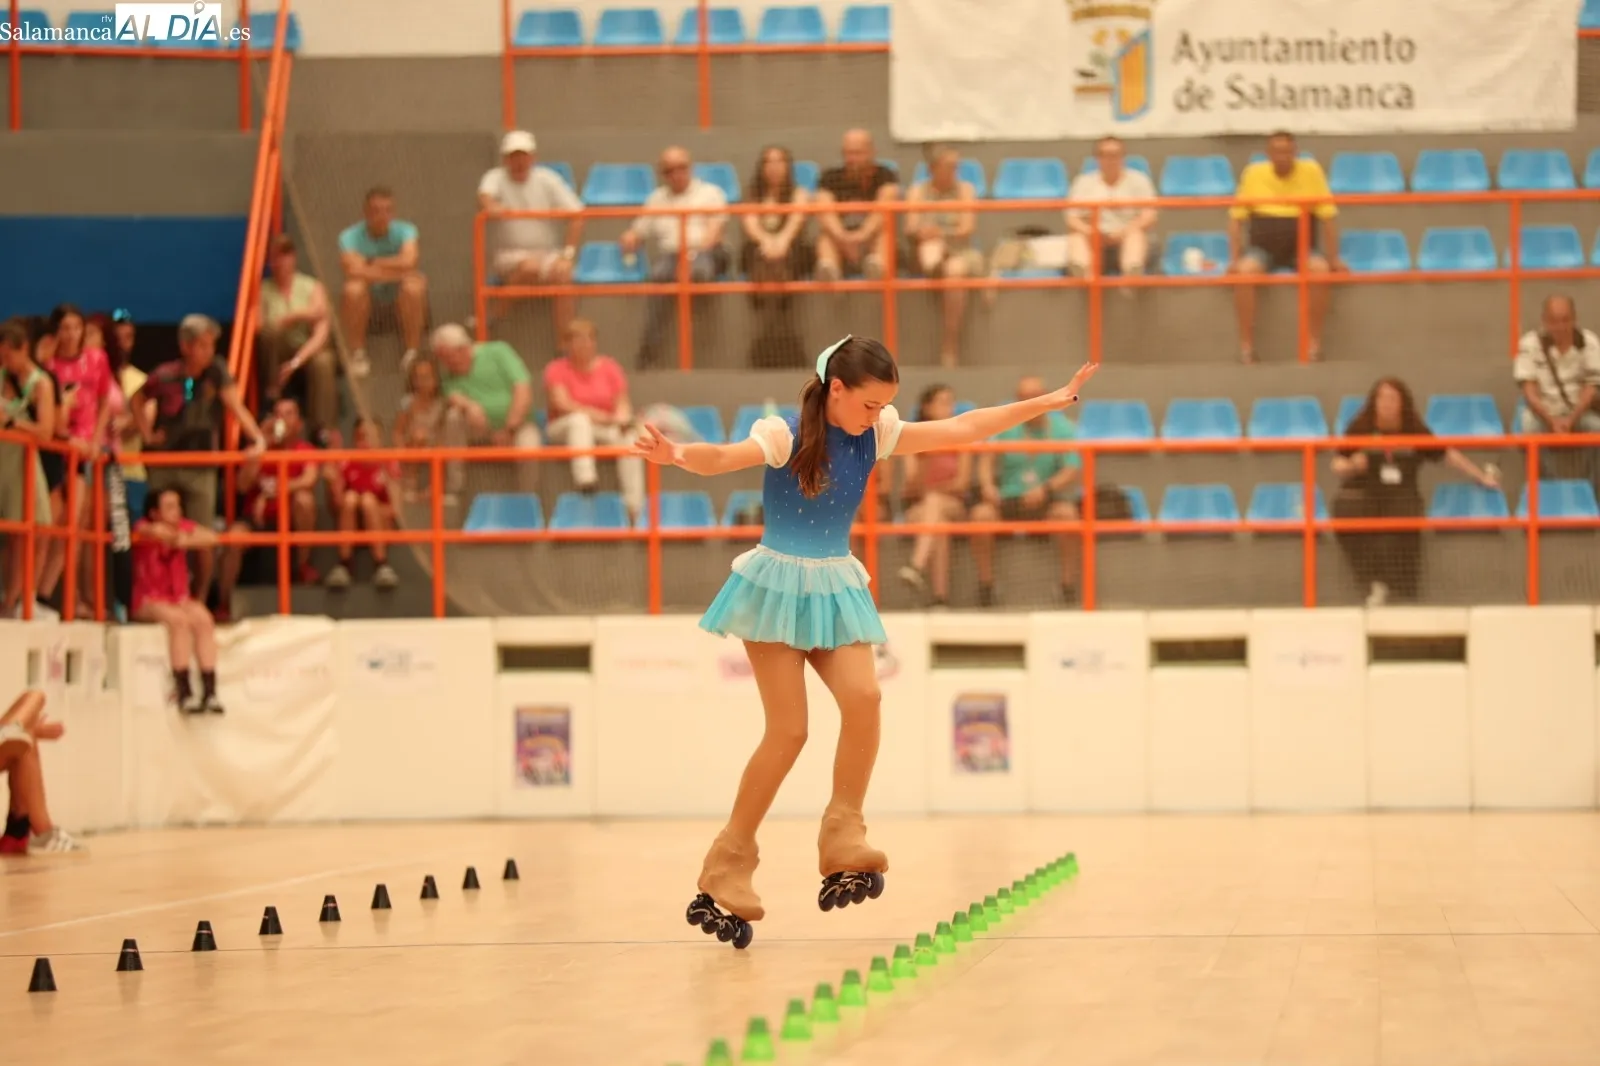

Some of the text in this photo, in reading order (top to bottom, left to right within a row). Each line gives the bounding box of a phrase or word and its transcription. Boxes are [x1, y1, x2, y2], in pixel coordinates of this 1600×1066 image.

[1172, 29, 1417, 73] Ayuntamiento
[1173, 74, 1415, 112] de Salamanca
